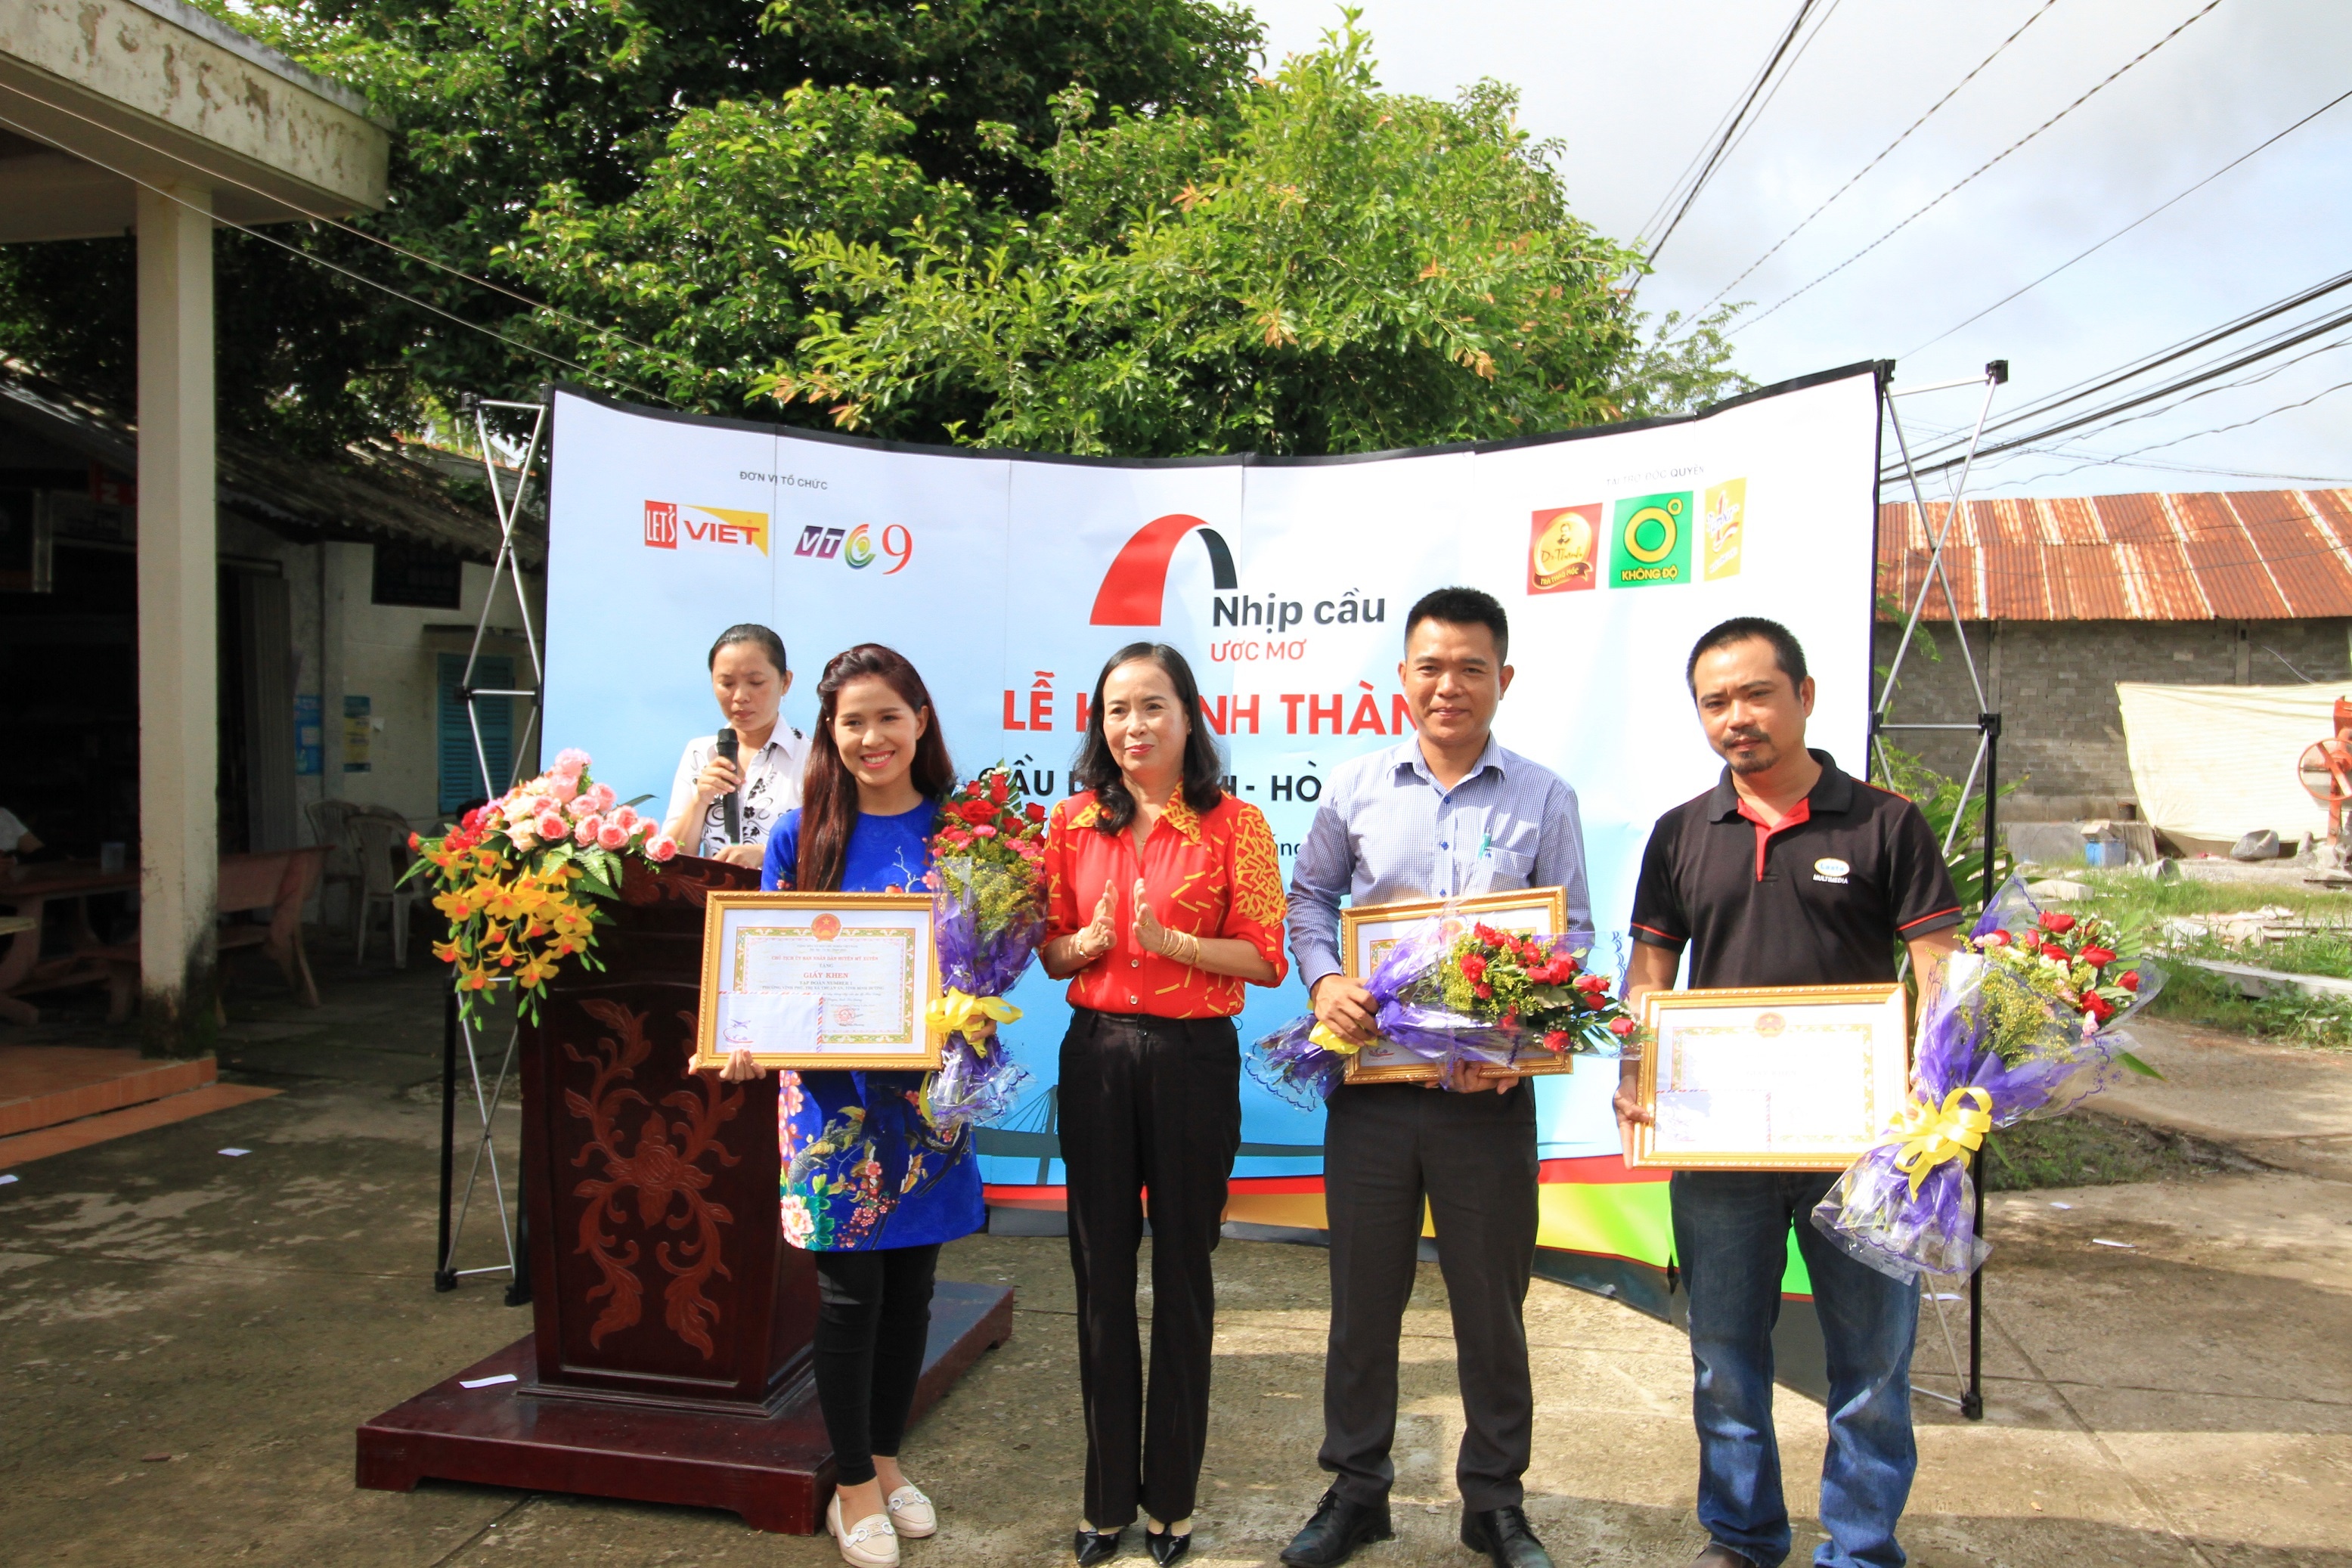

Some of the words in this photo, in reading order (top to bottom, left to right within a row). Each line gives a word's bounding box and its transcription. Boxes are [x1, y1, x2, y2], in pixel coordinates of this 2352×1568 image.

[739, 471, 765, 482] ĐƠN
[768, 474, 778, 486] VỊ
[780, 474, 795, 486] TỔ
[797, 478, 828, 490] CHỨC
[1670, 463, 1704, 478] QUYỀN
[646, 504, 676, 544] LET'S
[683, 519, 761, 546] VIET
[1621, 566, 1662, 581] KHÔNG
[1662, 563, 1678, 581] ĐỘ
[1213, 592, 1303, 634] Nhịp
[1313, 587, 1386, 625] cầu
[1266, 638, 1307, 661] MƠ
[1003, 671, 1055, 732] LỄ
[1812, 873, 1849, 885] MULTIMEDIA
[803, 969, 823, 978] GIẤY
